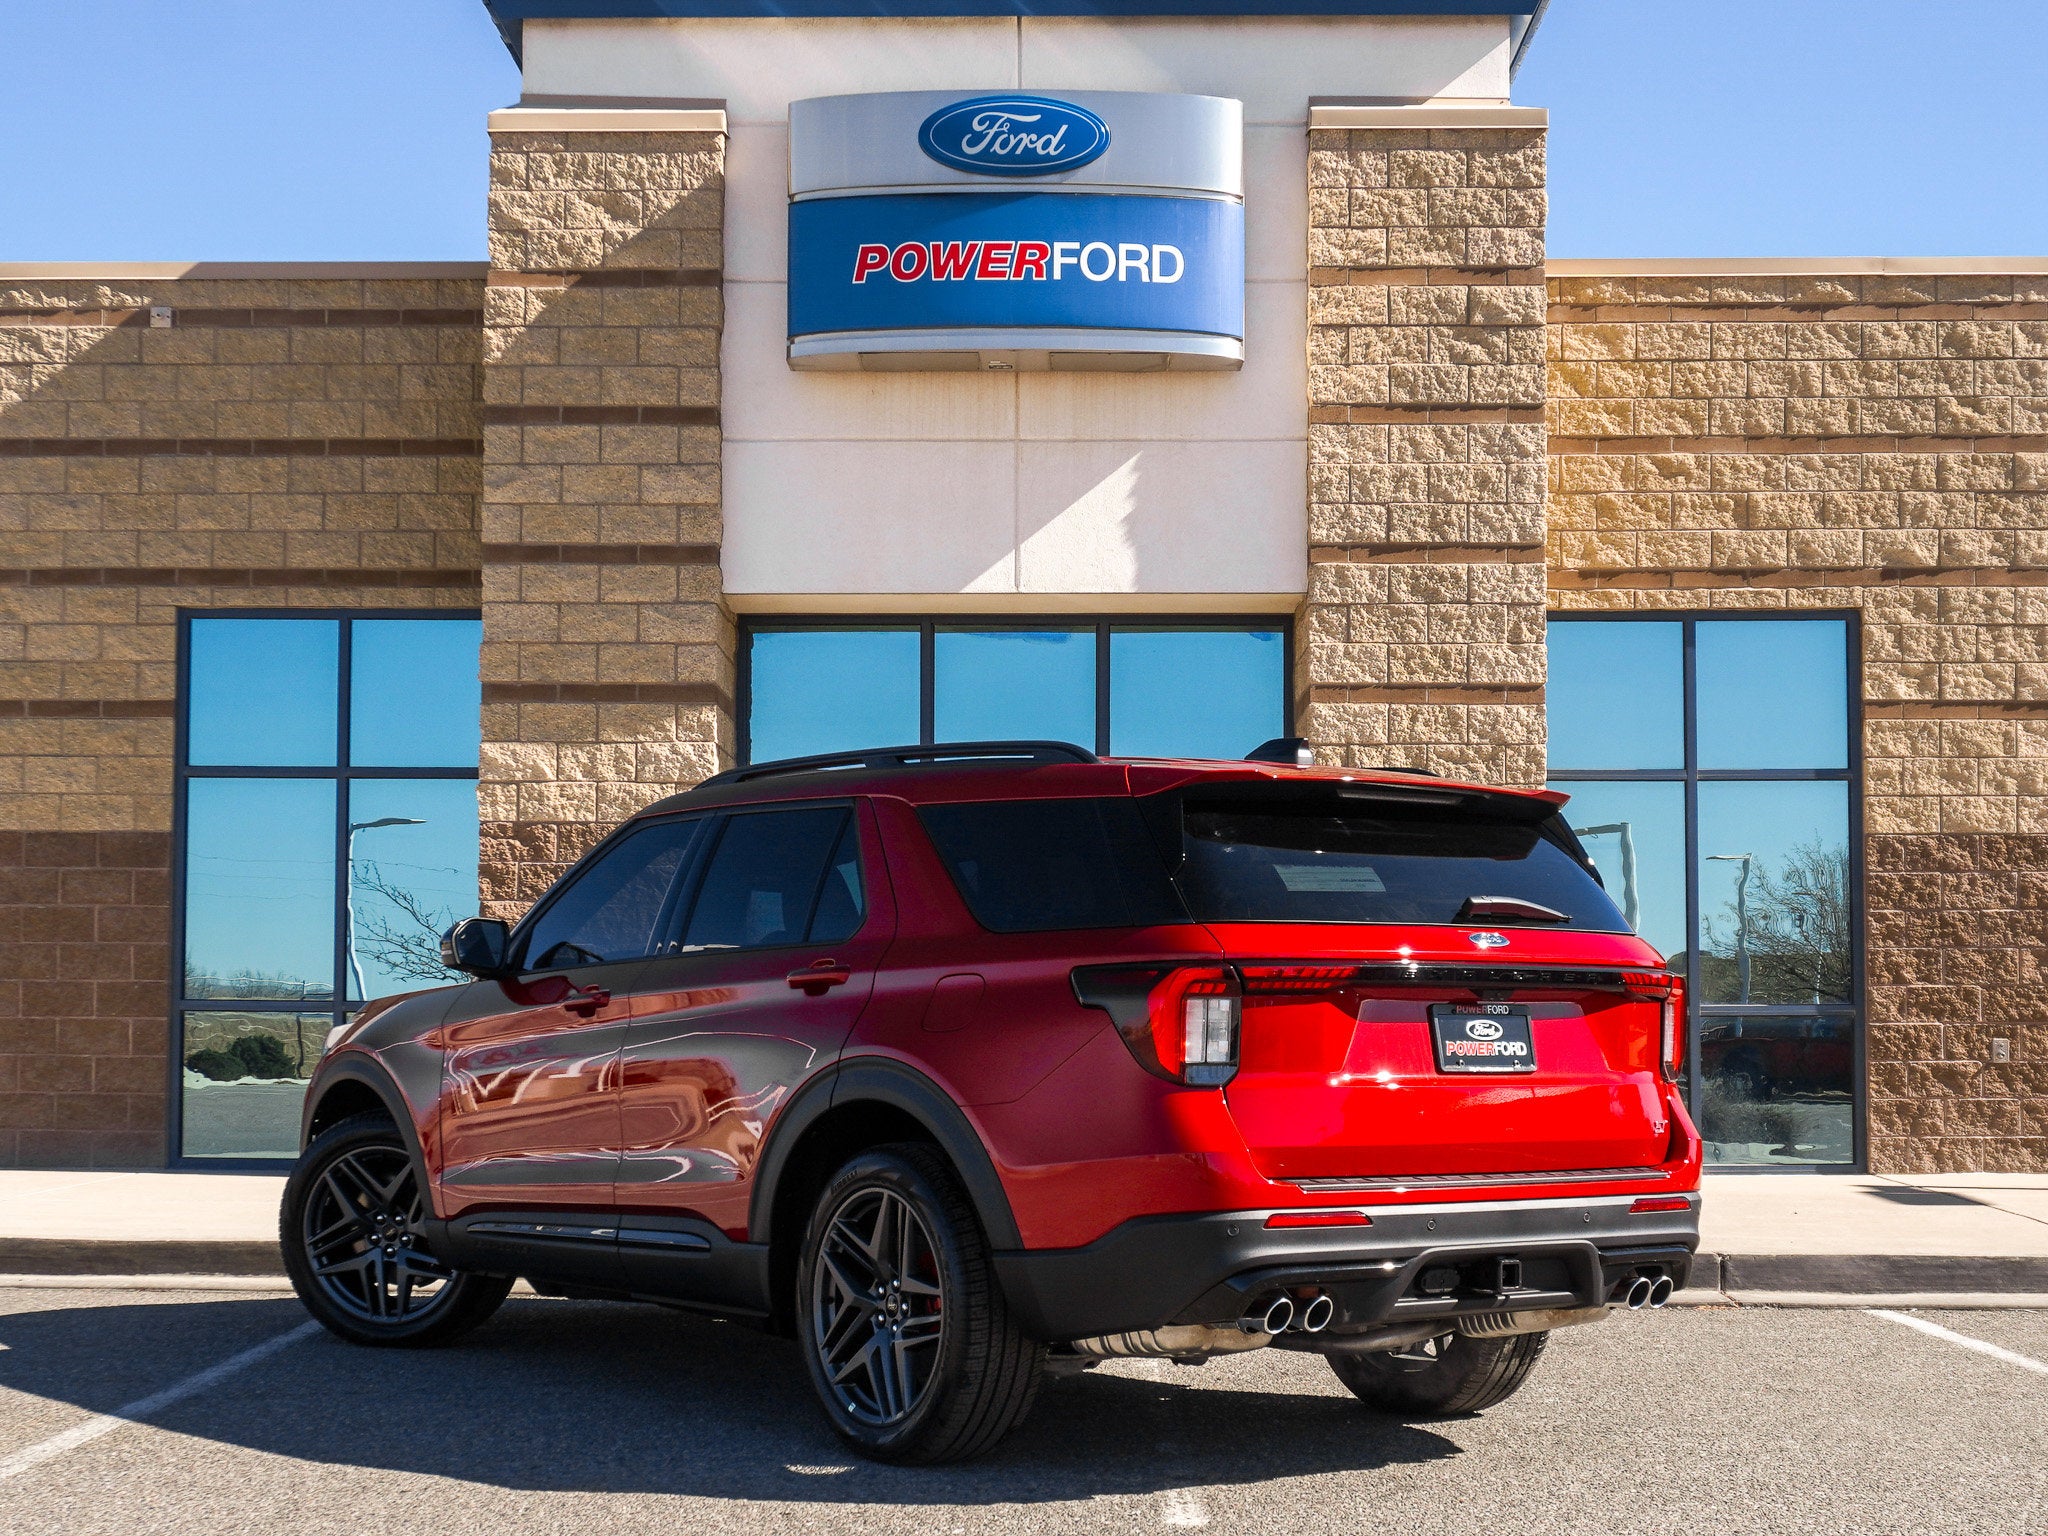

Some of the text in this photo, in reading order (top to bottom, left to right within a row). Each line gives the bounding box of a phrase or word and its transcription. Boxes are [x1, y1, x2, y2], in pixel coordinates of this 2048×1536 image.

[961, 111, 1069, 157] Ford
[852, 241, 1185, 284] POWERFORD
[1456, 1005, 1510, 1015] POWERFORD
[1473, 1023, 1497, 1036] Ford
[1446, 1041, 1528, 1057] POWERFORD
